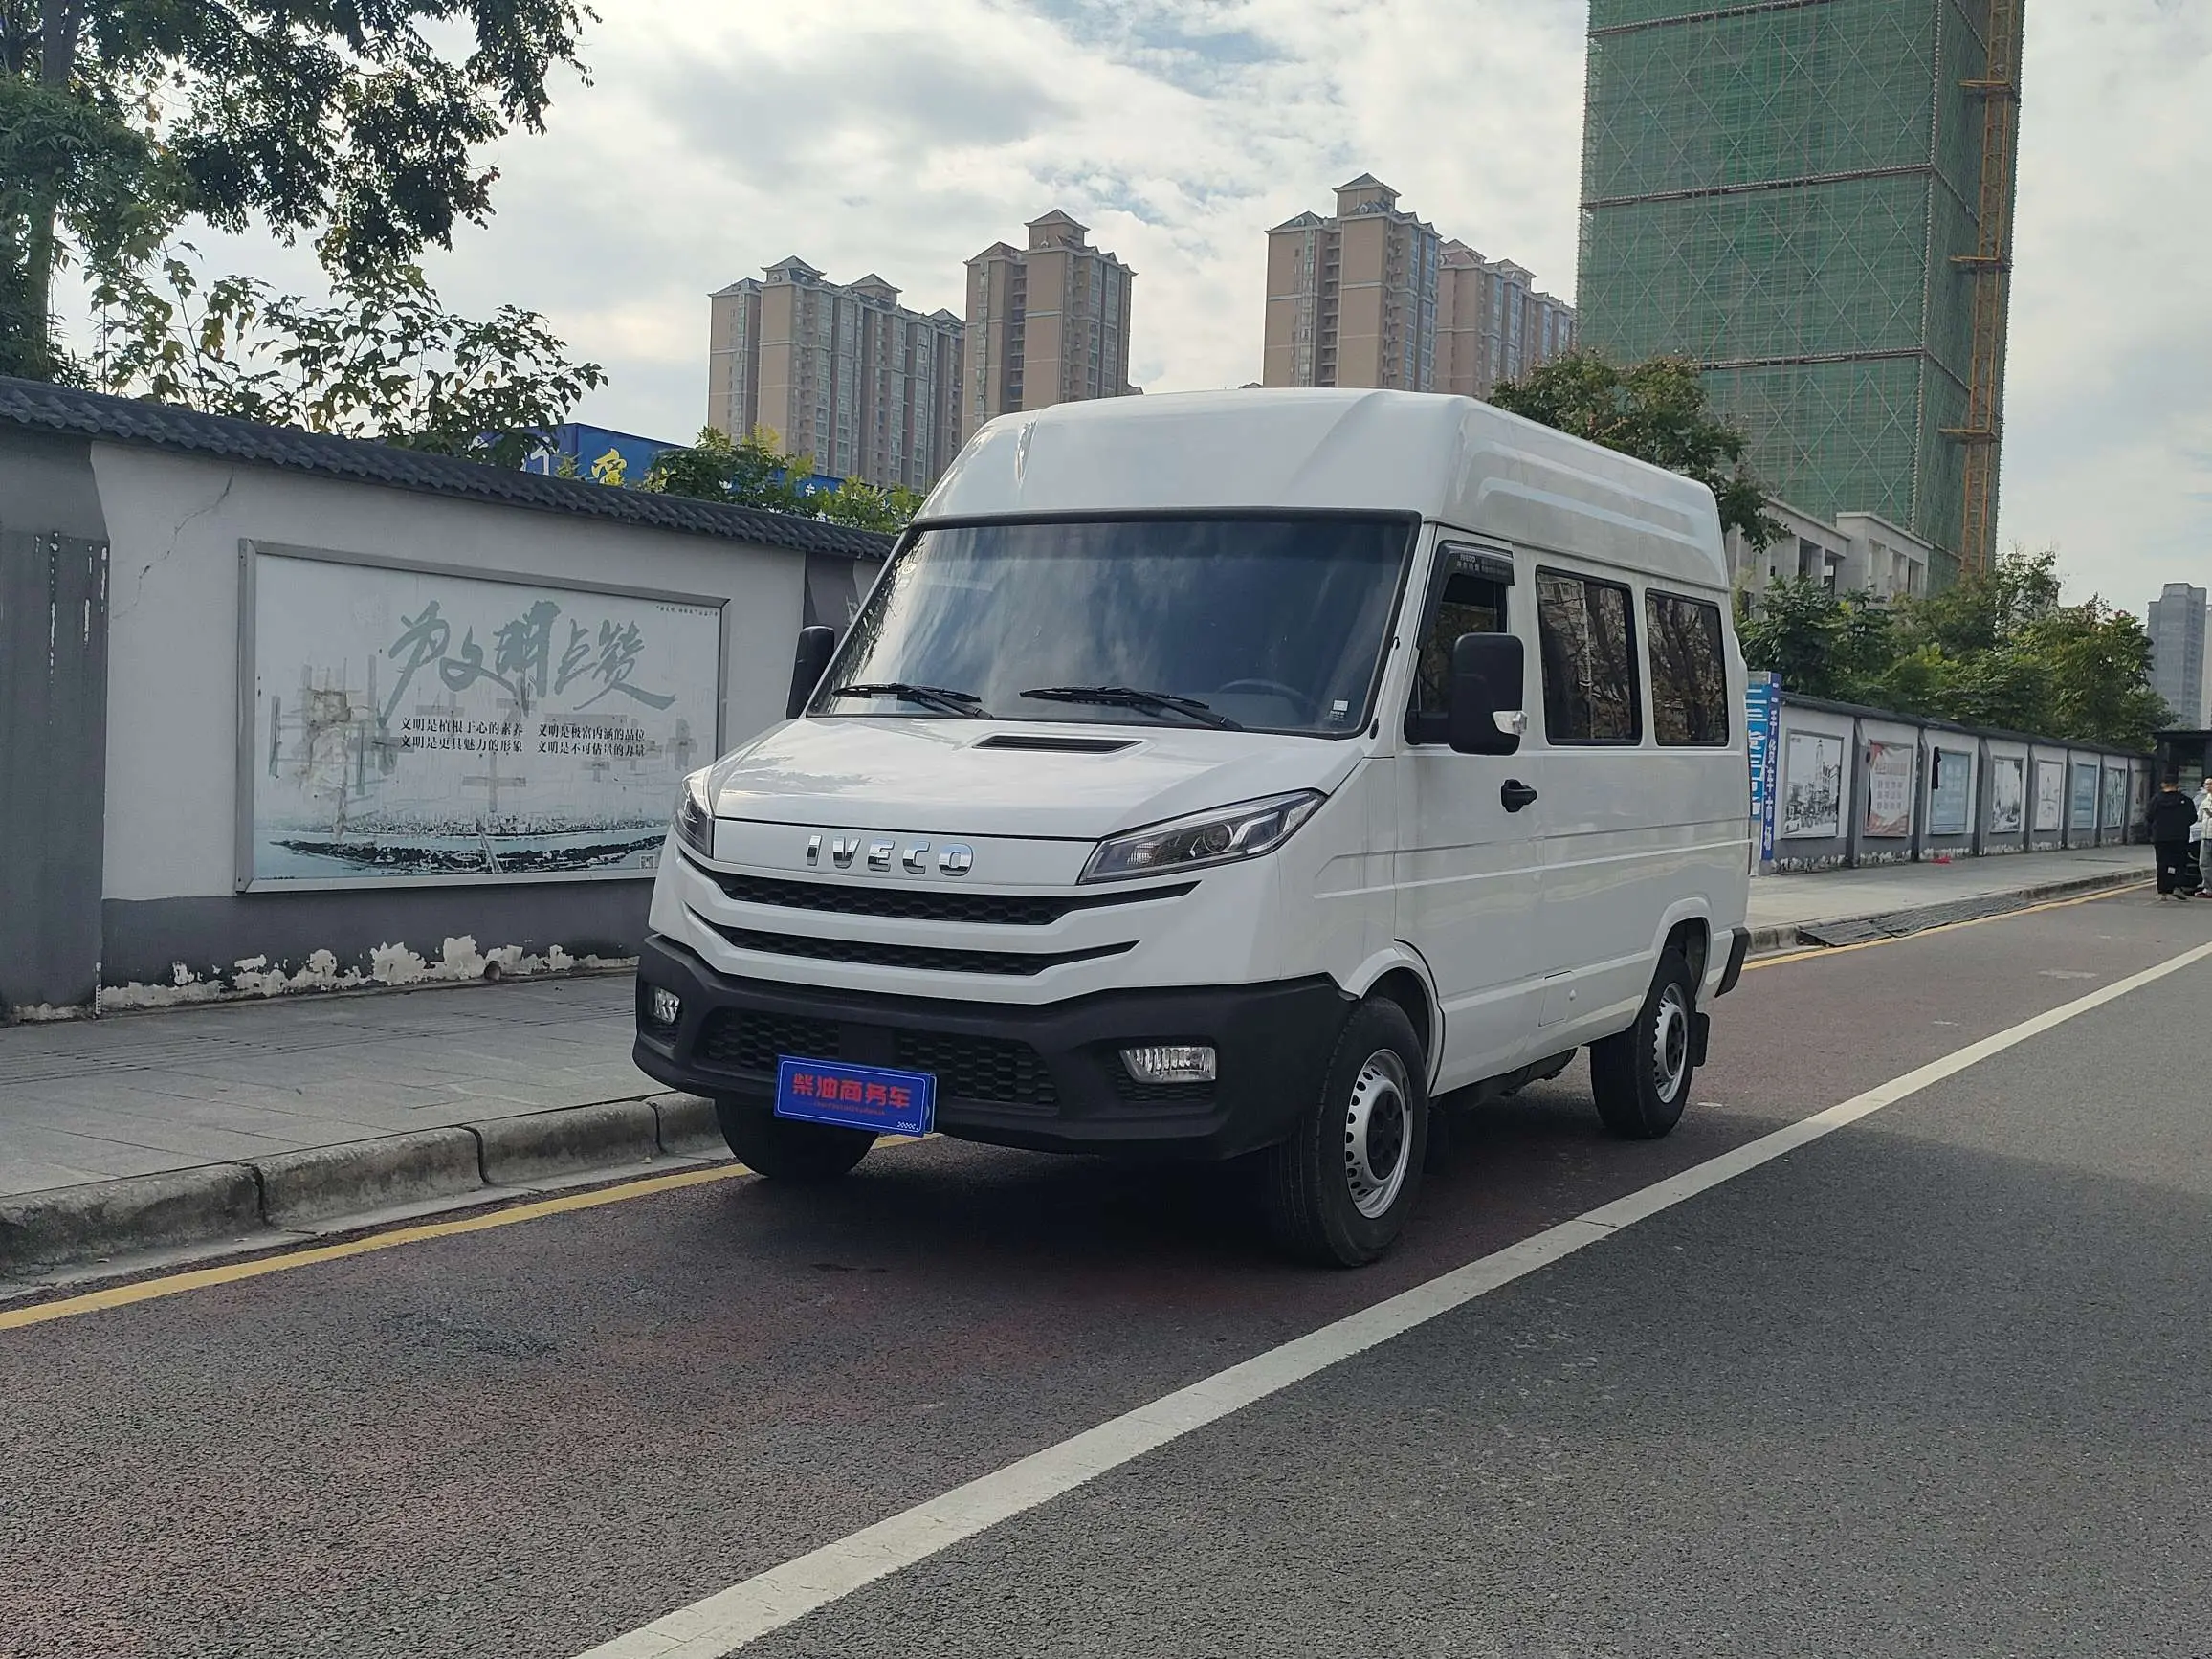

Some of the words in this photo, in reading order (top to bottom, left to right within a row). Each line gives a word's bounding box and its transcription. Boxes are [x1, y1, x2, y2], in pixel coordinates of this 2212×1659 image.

[378, 600, 676, 727] 为文明点赞
[400, 717, 524, 737] 文明是植根于心的素养
[400, 734, 523, 753] 文明是更具魅力的形象
[537, 741, 646, 758] 文明是不可估量的力量
[806, 834, 975, 876] IVECO
[791, 1072, 912, 1109] 柴油商务车
